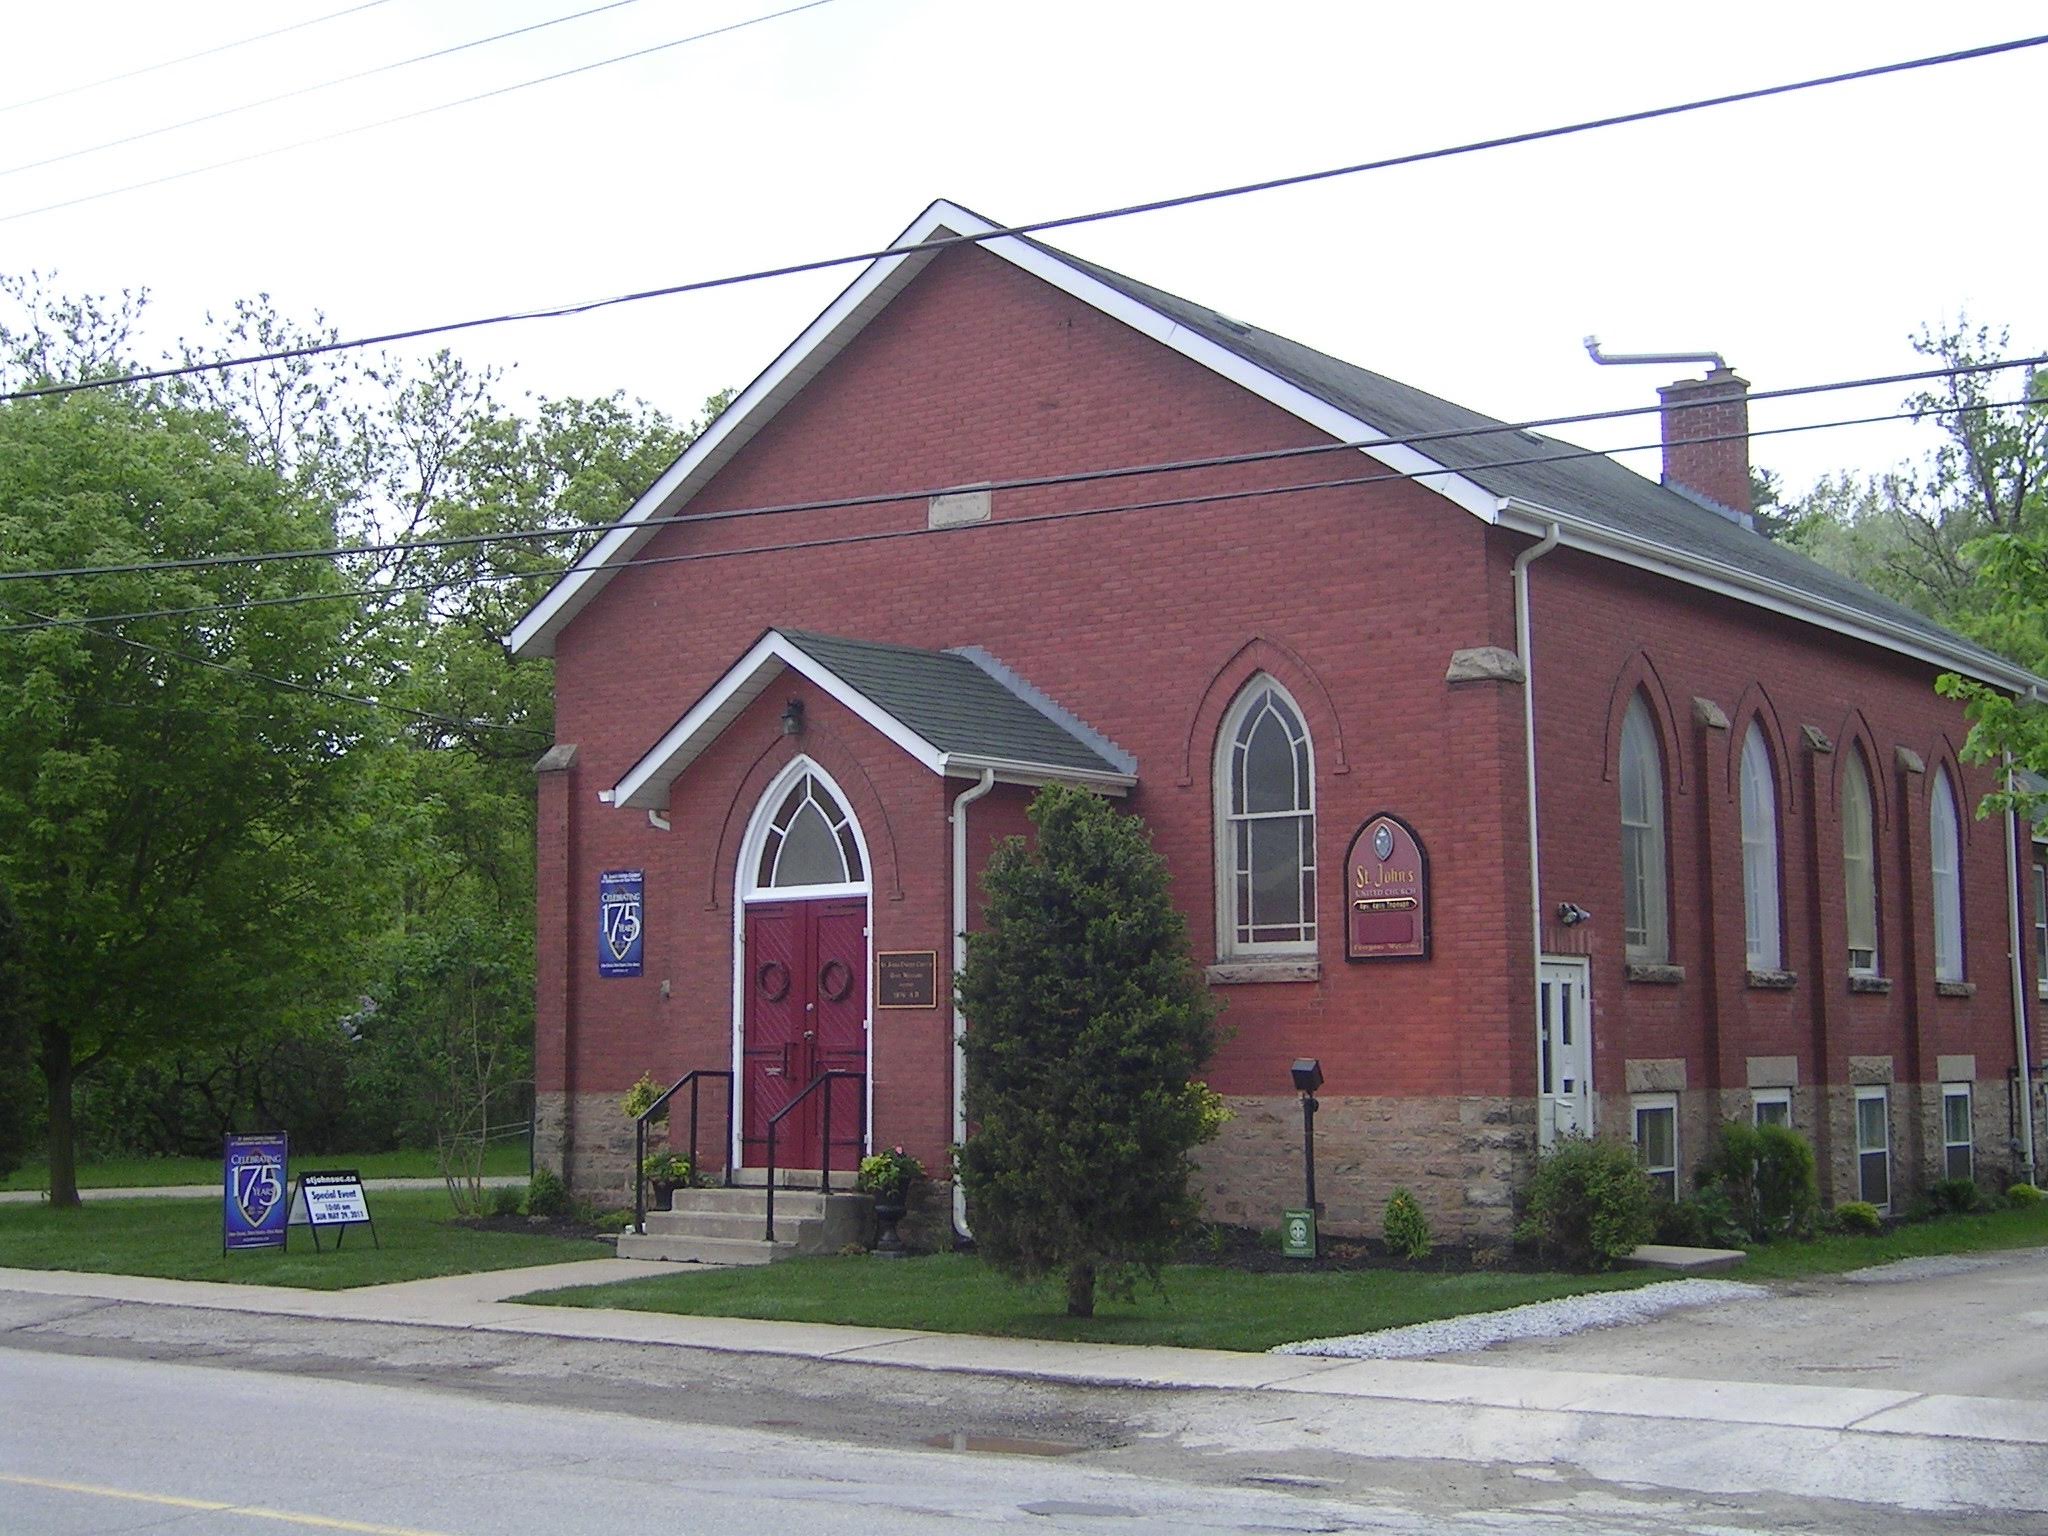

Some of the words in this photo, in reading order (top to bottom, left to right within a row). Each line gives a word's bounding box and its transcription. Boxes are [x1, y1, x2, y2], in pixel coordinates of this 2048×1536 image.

[1355, 889, 1383, 897] UNITED
[1384, 887, 1416, 896] CHURCH
[602, 902, 641, 943] 175
[231, 1154, 281, 1165] CELEBRATING
[306, 1175, 356, 1185] stjohnsuc.ca
[232, 1164, 282, 1208] 175
[252, 1186, 274, 1197] YEARS
[312, 1189, 336, 1200] Special
[337, 1189, 356, 1199] Event
[325, 1203, 341, 1211] 10:00
[315, 1212, 327, 1220] SUN
[328, 1211, 340, 1219] MAY
[350, 1210, 364, 1218] 2011
